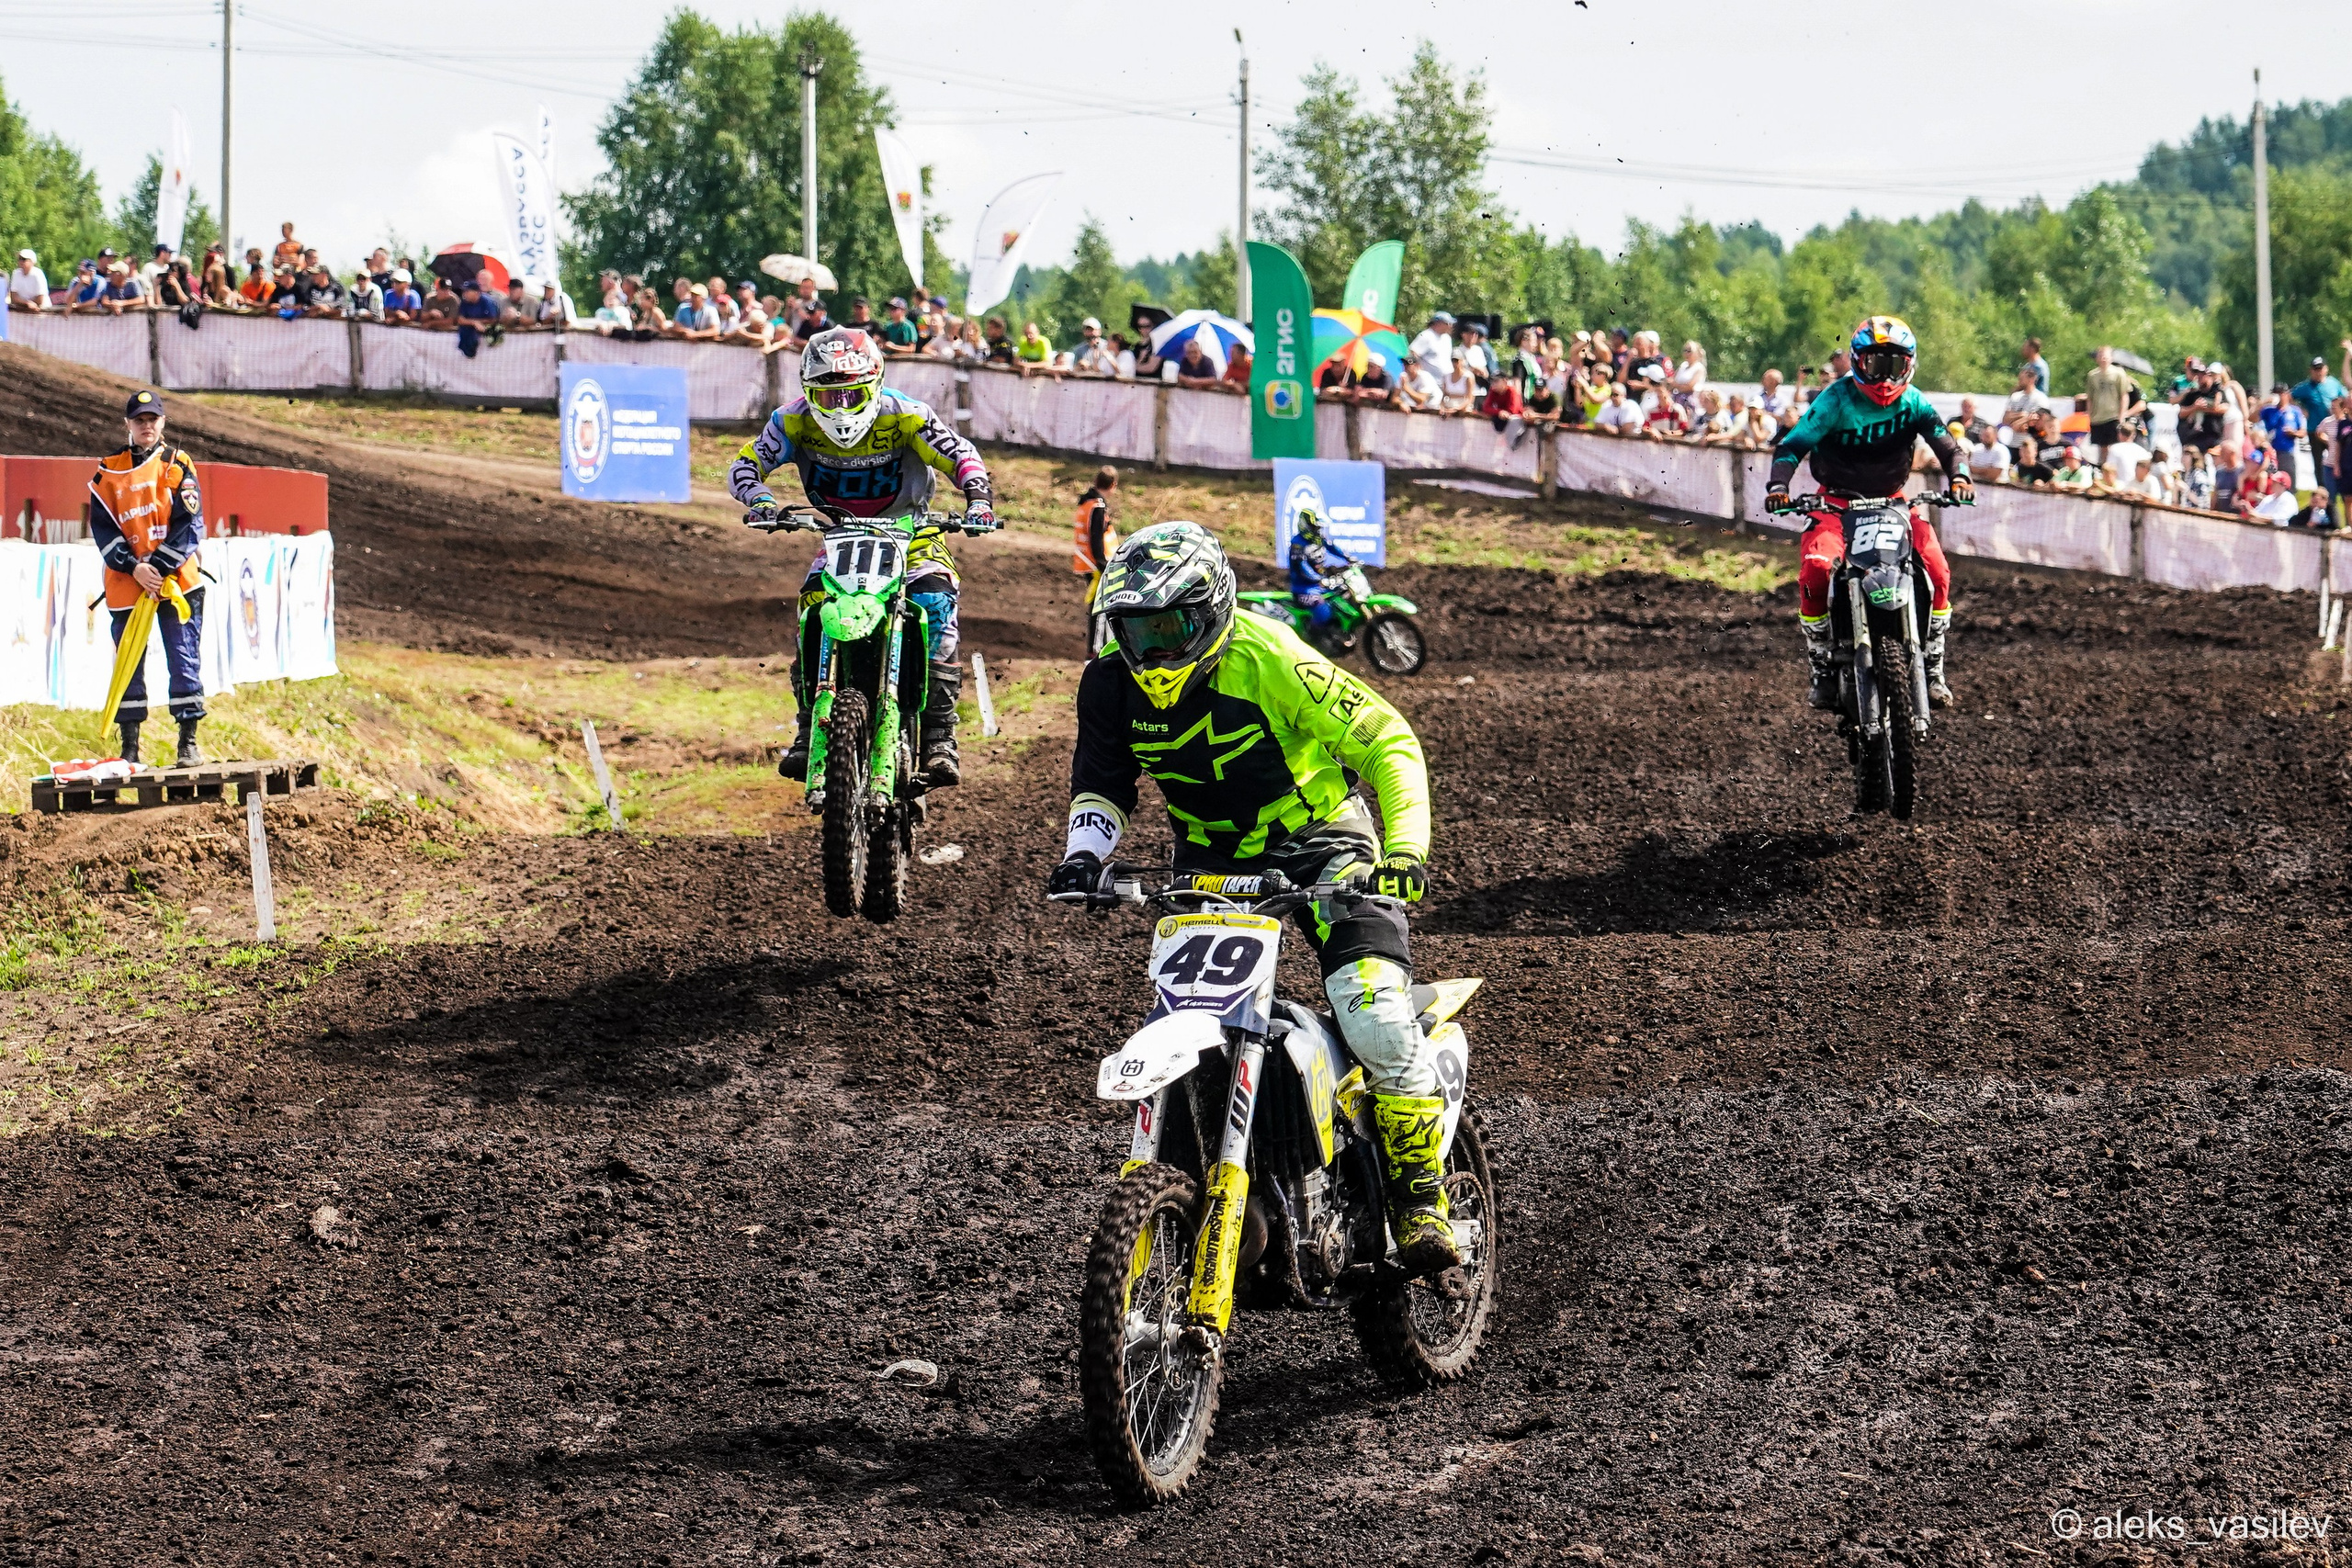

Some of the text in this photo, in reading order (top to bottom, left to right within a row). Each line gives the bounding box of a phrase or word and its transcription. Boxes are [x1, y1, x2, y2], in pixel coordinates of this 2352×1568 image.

[1276, 308, 1295, 376] 2ГИС
[850, 453, 892, 468] division
[812, 460, 900, 499] FOX
[119, 502, 159, 525] АРША
[1851, 523, 1905, 556] 82
[835, 540, 897, 578] 111
[1108, 592, 1136, 604] HOEI
[1132, 718, 1169, 732] Astars
[1158, 934, 1264, 987] 49
